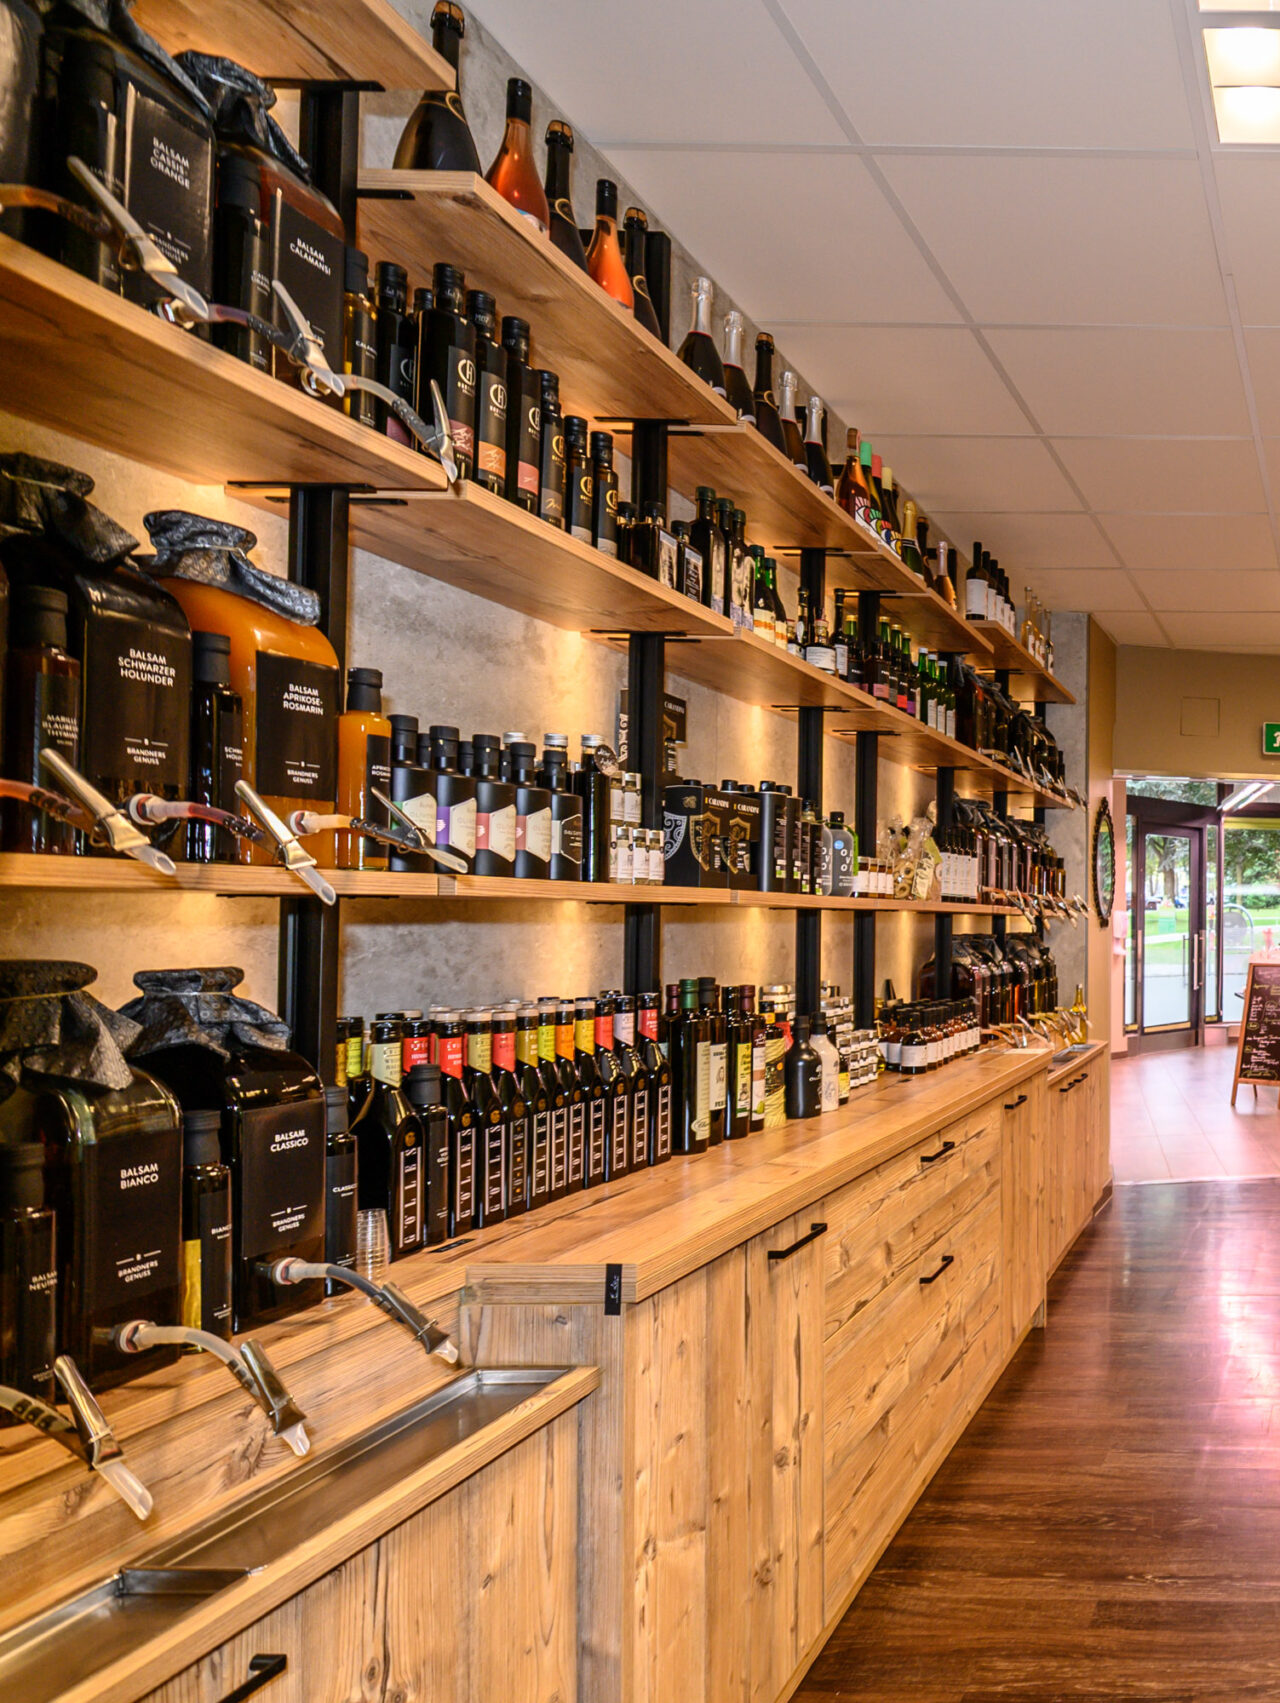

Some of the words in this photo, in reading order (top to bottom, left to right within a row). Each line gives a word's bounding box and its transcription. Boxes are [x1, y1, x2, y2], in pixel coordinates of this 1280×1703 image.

[153, 136, 189, 168] BALSAM
[150, 157, 190, 190] ORANGE
[297, 237, 325, 262] BALSAM
[289, 242, 331, 276] CALAMANSI
[129, 648, 167, 665] BALSAM
[118, 656, 176, 678] SCHWARZER
[120, 667, 174, 688] HOLUNDER
[289, 683, 319, 696] BALSAM
[283, 692, 323, 706] APRIKOSE-
[283, 702, 324, 716] ROSMARIN
[126, 746, 166, 759] BRANDNERS
[133, 755, 160, 766] GENUSS
[274, 1129, 305, 1143] BALSAM
[270, 1137, 309, 1152] CLASSICO
[120, 1163, 159, 1179] BALSAM
[120, 1173, 159, 1190] BIANCO
[272, 1213, 305, 1228] BRANDNERS
[278, 1222, 300, 1232] GENUSS
[118, 1260, 159, 1278] BRANDNERS
[124, 1270, 151, 1283] GENUSS
